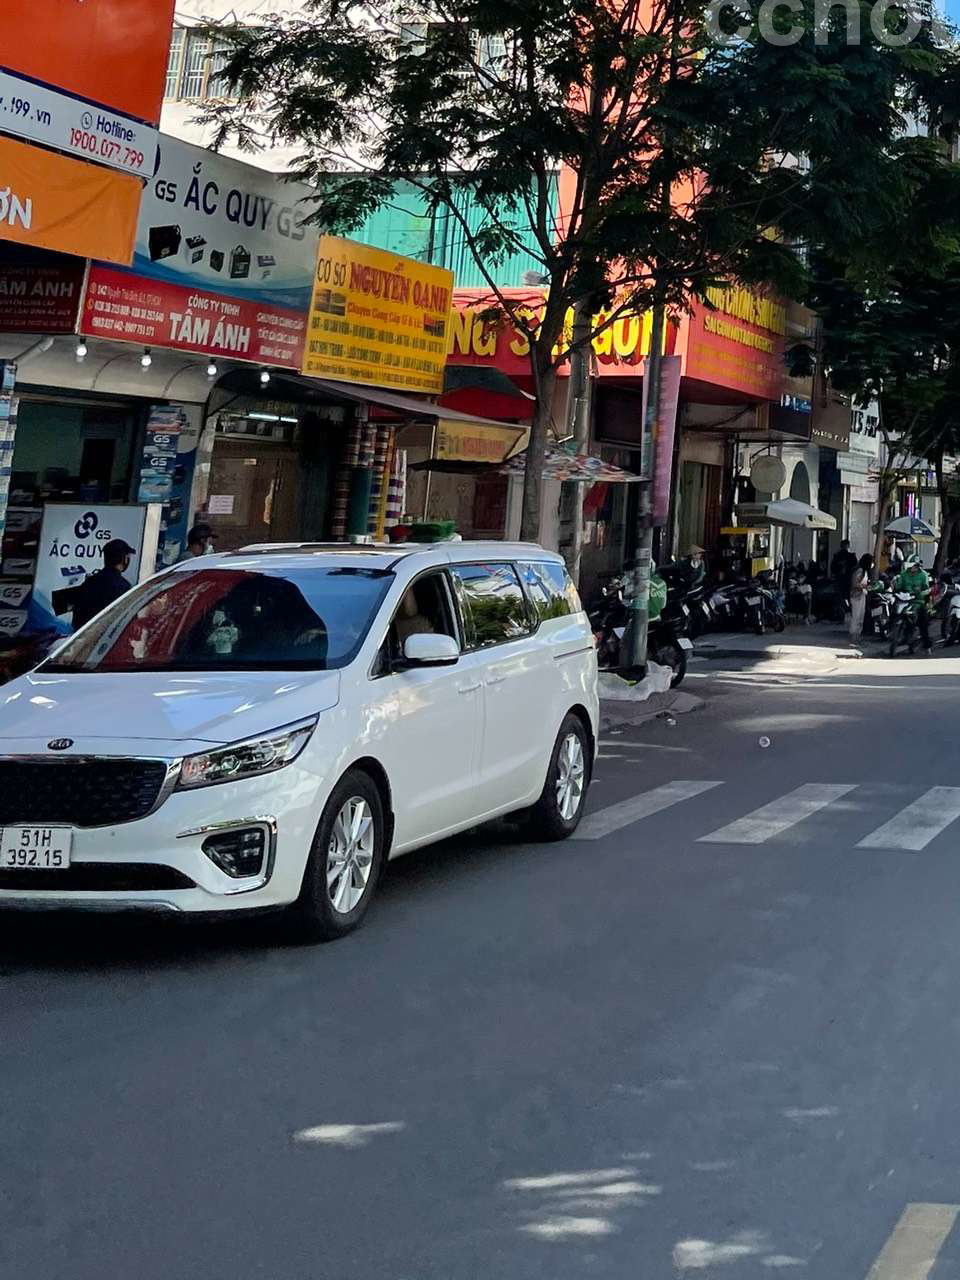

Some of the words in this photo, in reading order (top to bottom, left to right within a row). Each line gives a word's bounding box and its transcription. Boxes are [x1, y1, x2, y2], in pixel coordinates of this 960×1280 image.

[96, 114, 137, 142] Hotline:
[155, 179, 177, 203] GS
[183, 162, 219, 215] ẮC
[225, 189, 273, 231] QUY
[169, 308, 211, 346] TÂM
[210, 315, 250, 353] ÁNH
[153, 434, 170, 443] GS
[95, 530, 112, 540] GS
[20, 829, 52, 847] 51H
[7, 848, 62, 866] 392.15
